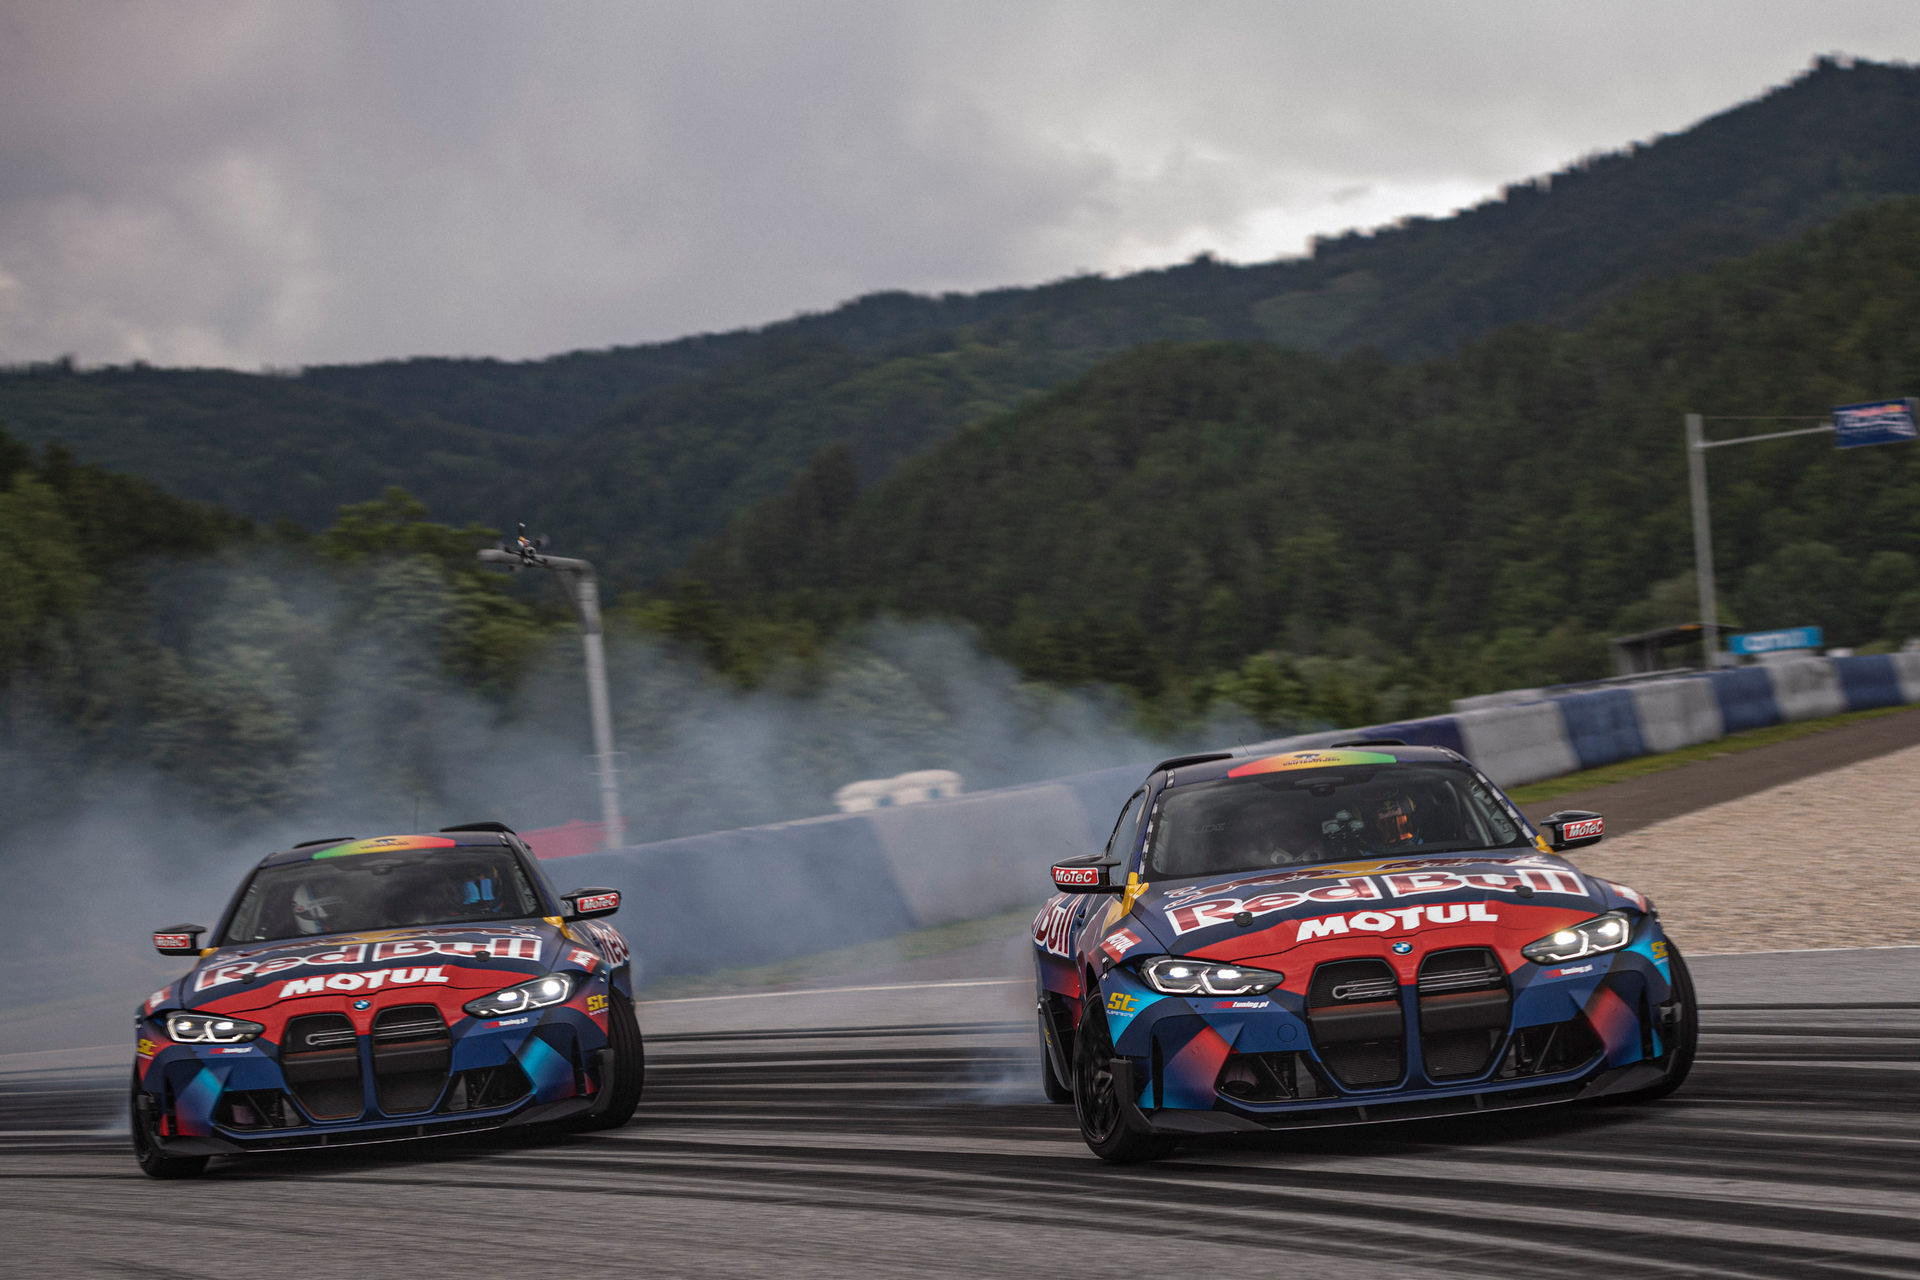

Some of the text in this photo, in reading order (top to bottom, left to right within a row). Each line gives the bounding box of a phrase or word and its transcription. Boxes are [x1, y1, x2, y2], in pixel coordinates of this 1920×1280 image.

[1568, 821, 1604, 837] MoTeC
[1055, 869, 1093, 882] MoTeC
[583, 895, 617, 910] MoTeC
[1164, 876, 1382, 937] Red
[1381, 869, 1590, 899] Bull
[1296, 903, 1499, 942] MOTUL
[193, 943, 369, 992] Red
[371, 937, 543, 962] Bull
[278, 966, 450, 998] MOTUL
